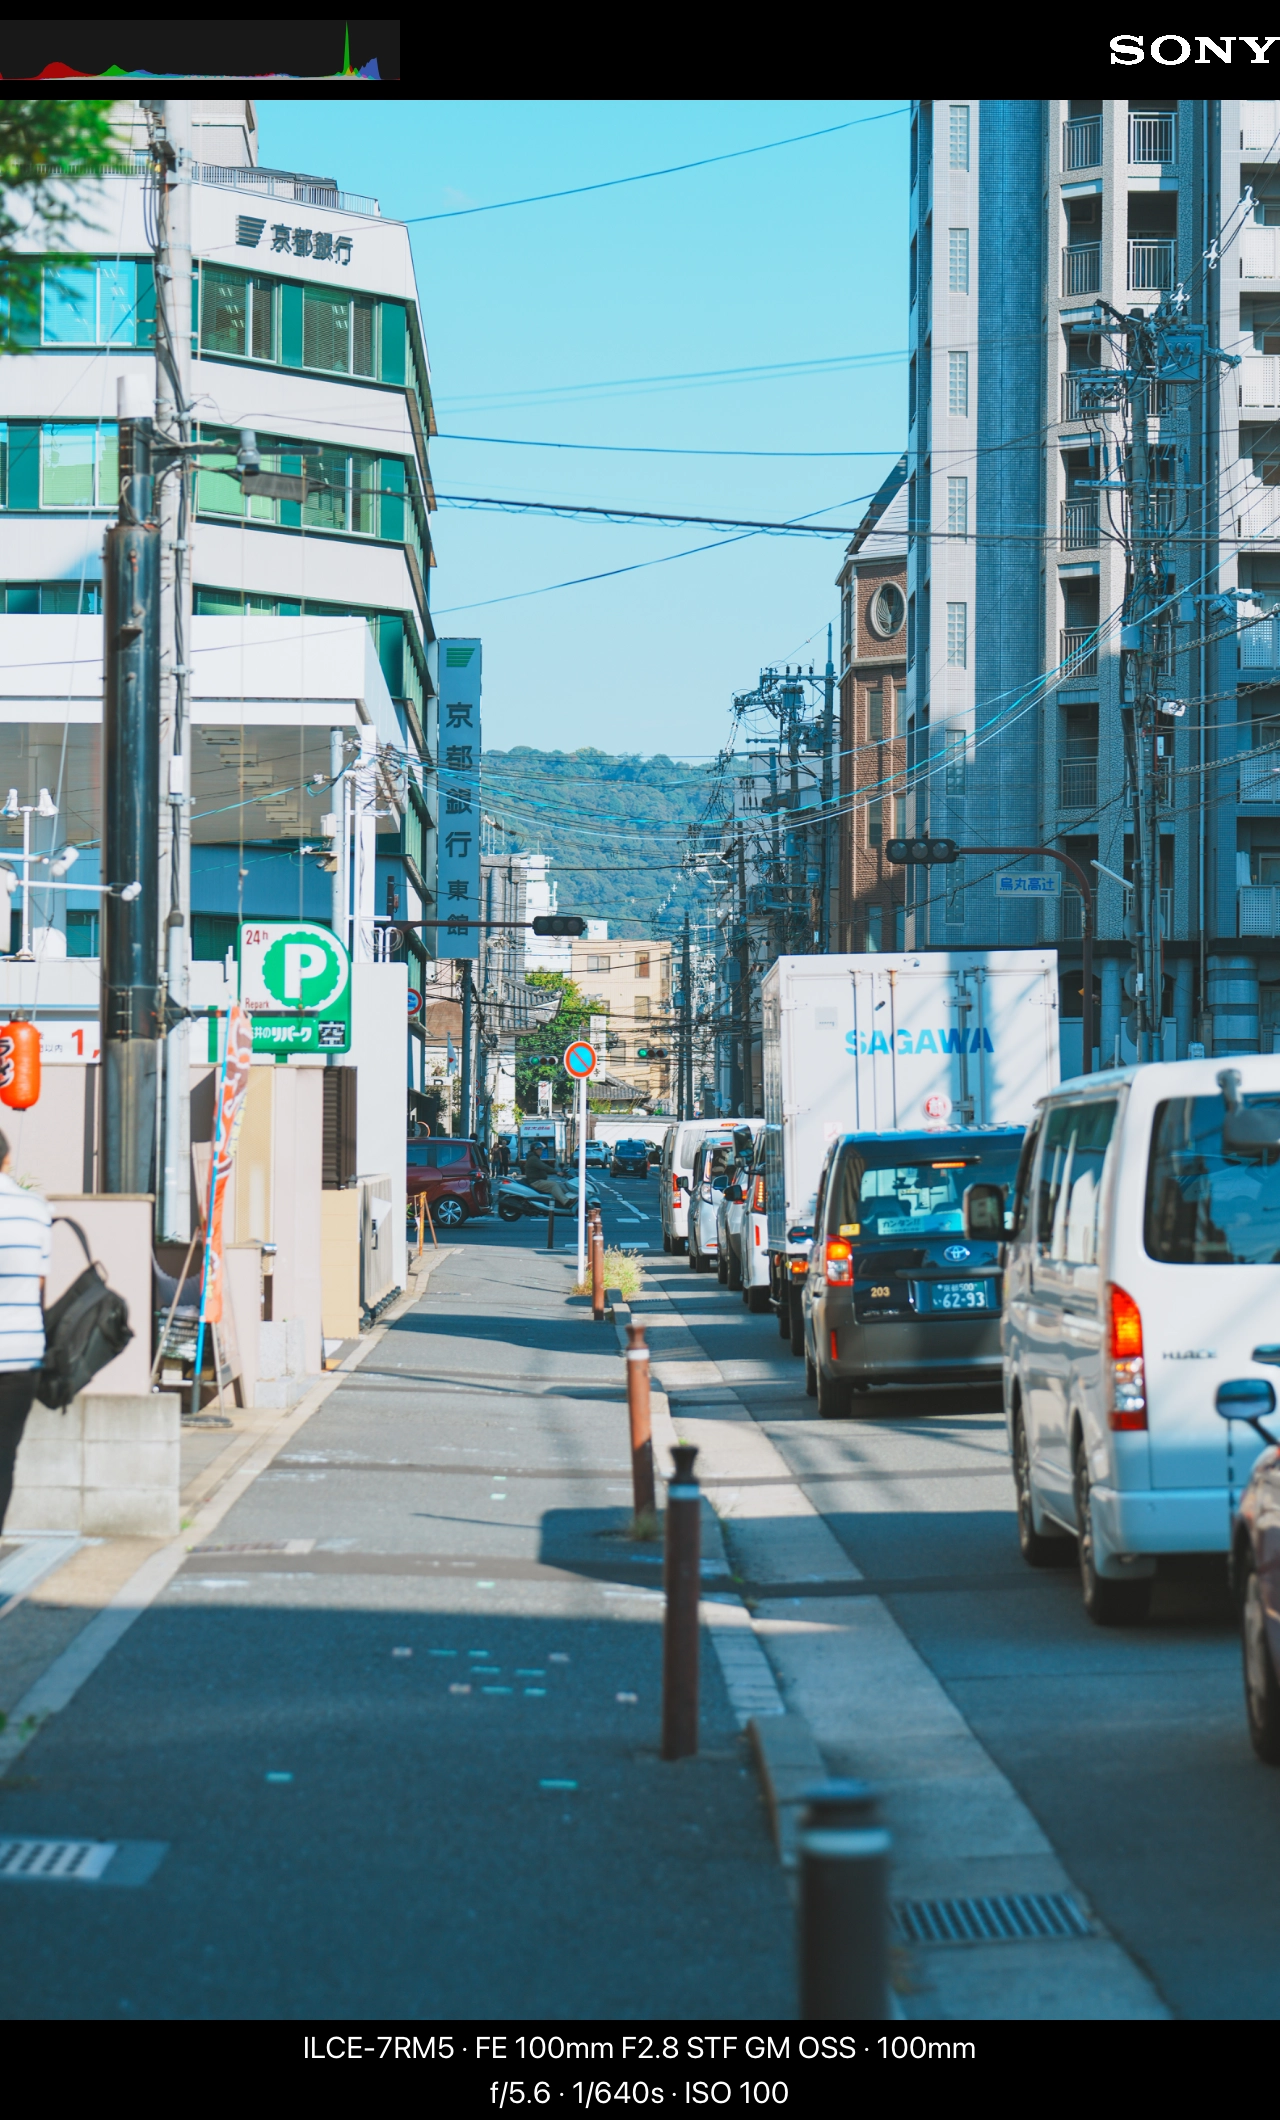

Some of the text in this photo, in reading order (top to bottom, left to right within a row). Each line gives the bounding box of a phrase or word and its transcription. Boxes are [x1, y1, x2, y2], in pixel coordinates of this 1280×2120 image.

[270, 223, 354, 266] 京都銀行
[1000, 877, 1055, 891] 烏丸高辻
[284, 943, 327, 998] P
[245, 998, 269, 1012] Repark
[251, 1025, 312, 1042] 井のリパーク
[318, 1021, 345, 1047] 空
[845, 1027, 994, 1056] SAGAWA
[870, 1287, 891, 1298] 203
[943, 1292, 985, 1308] 62-93
